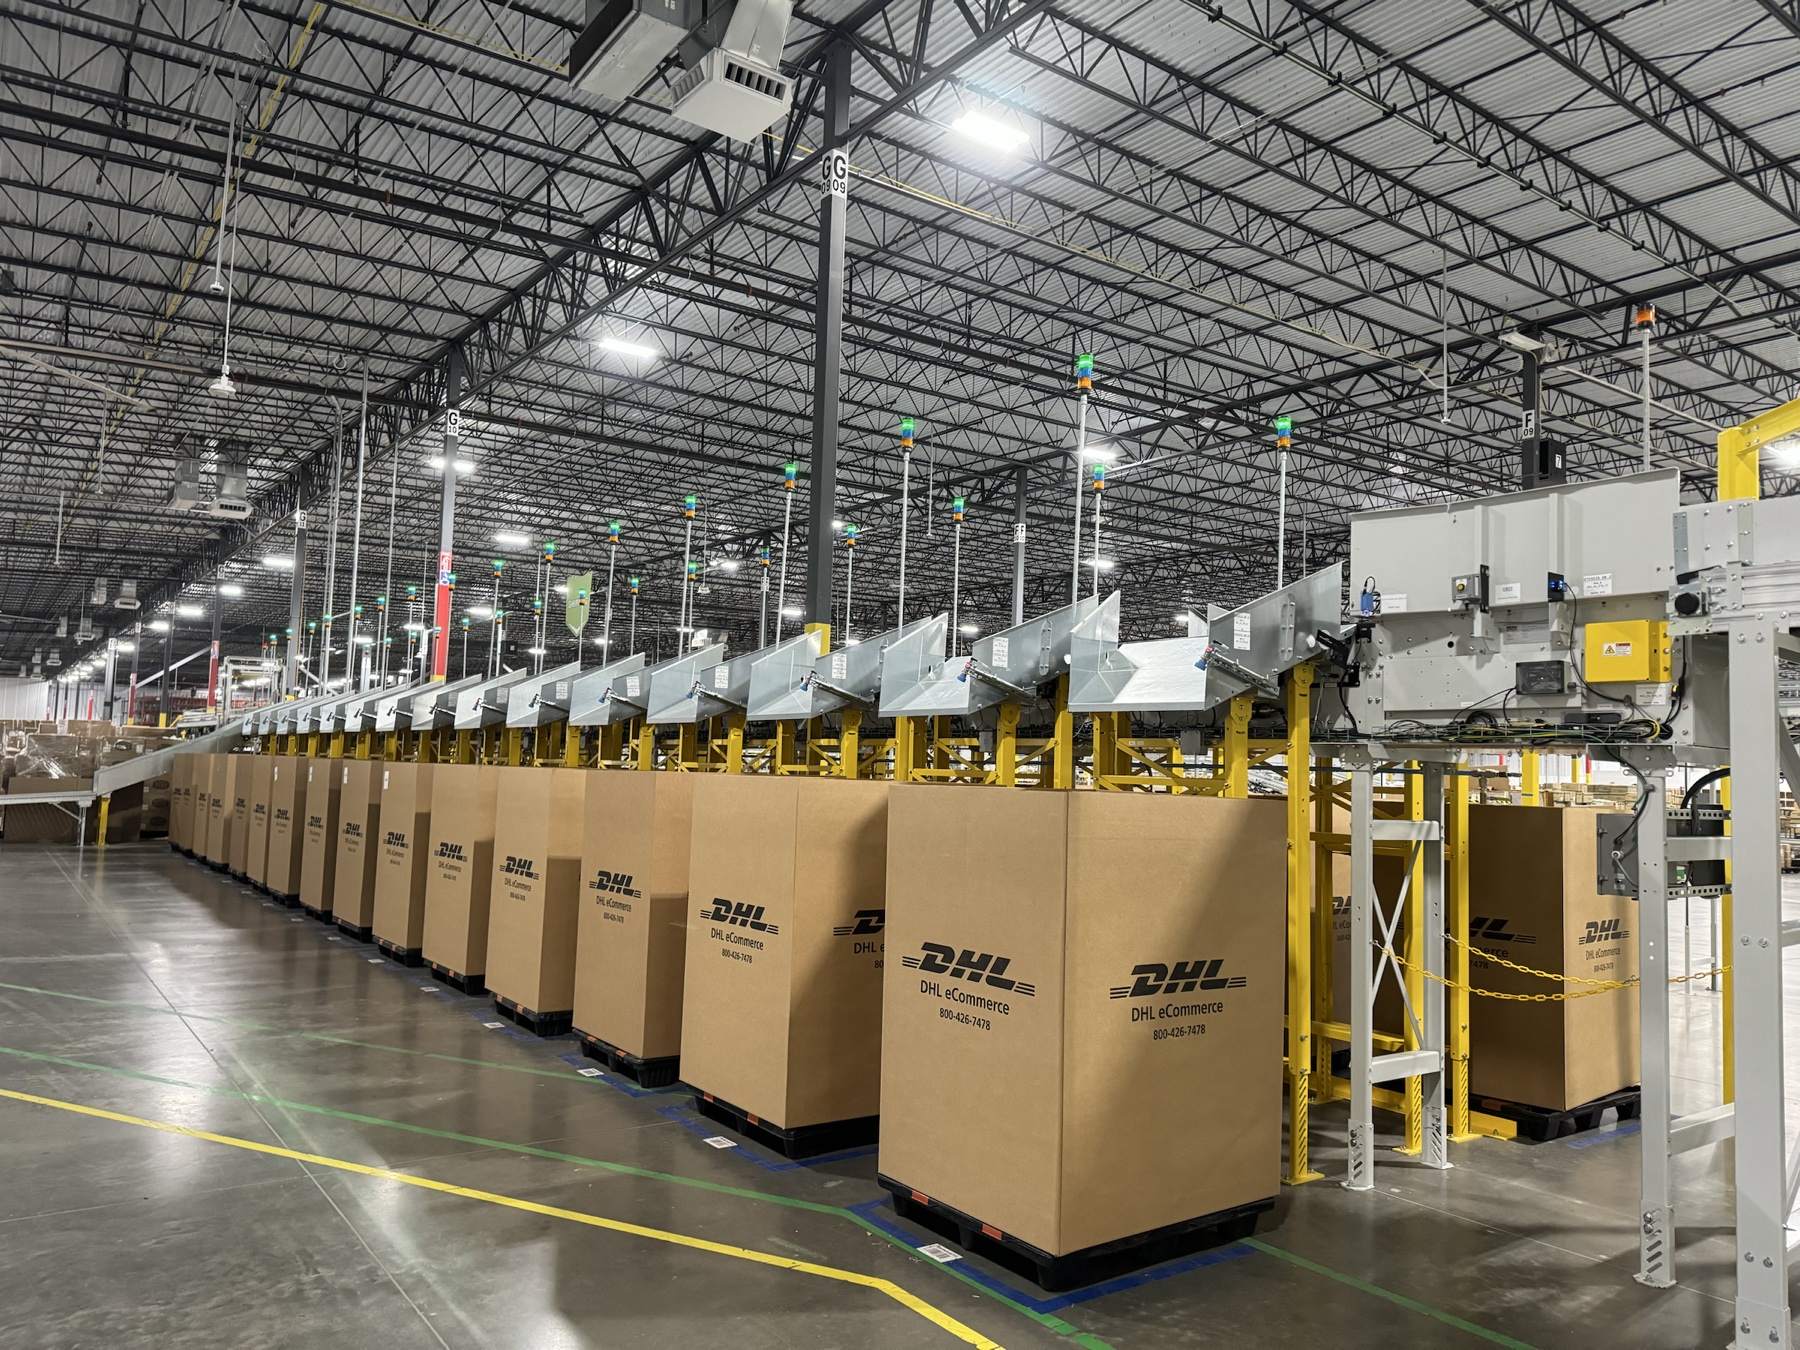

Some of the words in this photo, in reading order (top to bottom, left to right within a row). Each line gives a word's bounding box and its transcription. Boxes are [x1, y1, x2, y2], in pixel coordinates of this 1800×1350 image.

[822, 155, 832, 180] G
[834, 155, 847, 180] G
[821, 179, 831, 194] 09
[832, 179, 846, 194] 09
[448, 412, 458, 426] G
[1525, 413, 1533, 428] F
[448, 425, 457, 434] 10
[1523, 428, 1534, 437] 09
[1556, 455, 1562, 468] 7
[299, 512, 306, 522] G
[387, 831, 406, 848] DHL
[439, 842, 463, 861] DHL
[505, 856, 534, 879] DHL
[596, 870, 635, 897] DHL
[596, 895, 606, 907] DHL
[606, 898, 632, 912] eCommerce
[710, 898, 768, 932] DHL
[711, 928, 725, 941] DHL
[725, 932, 764, 951] eCommerce
[1585, 918, 1622, 944] DHL
[721, 948, 753, 964] 800-426-7478
[853, 942, 877, 954] DHL
[918, 942, 1017, 991] DHL
[1128, 958, 1230, 998] DHL
[920, 979, 943, 998] DHL
[944, 987, 1010, 1016] eCommerce
[939, 1007, 991, 1031] 800-426-7478
[1131, 1005, 1156, 1022] DHL
[1158, 1001, 1224, 1019] eCommerce
[1153, 1024, 1206, 1041] 800-426-7478
